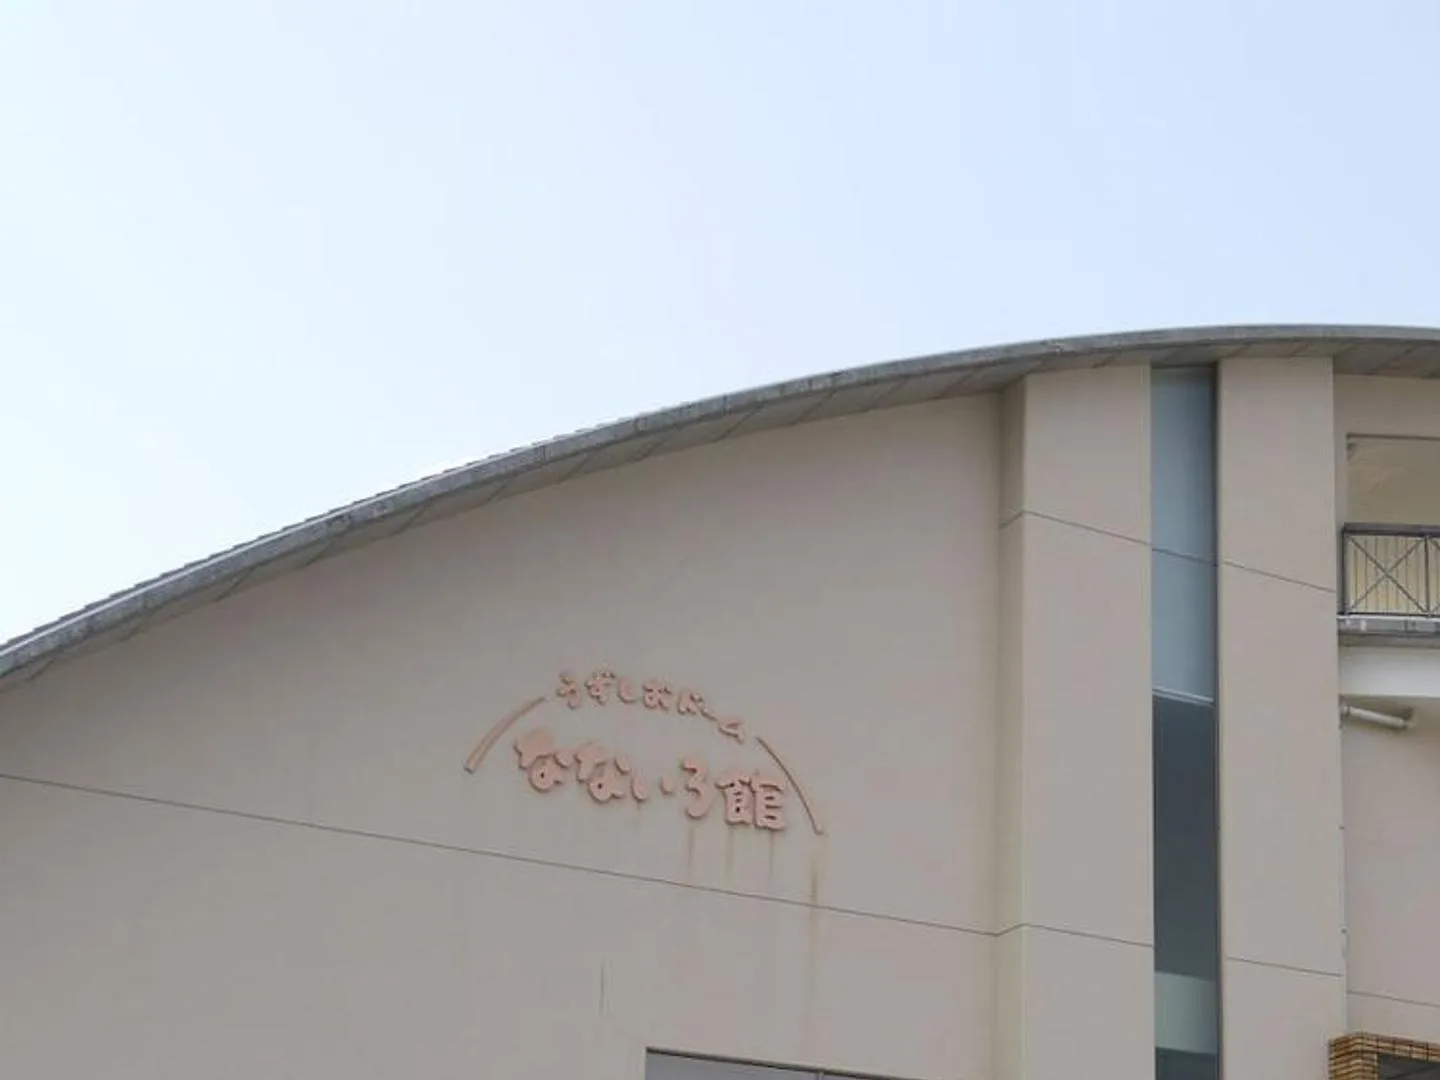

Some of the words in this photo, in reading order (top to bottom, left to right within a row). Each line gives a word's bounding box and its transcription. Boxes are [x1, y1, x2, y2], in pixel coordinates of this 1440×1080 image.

[513, 732, 787, 832] なないろ館
